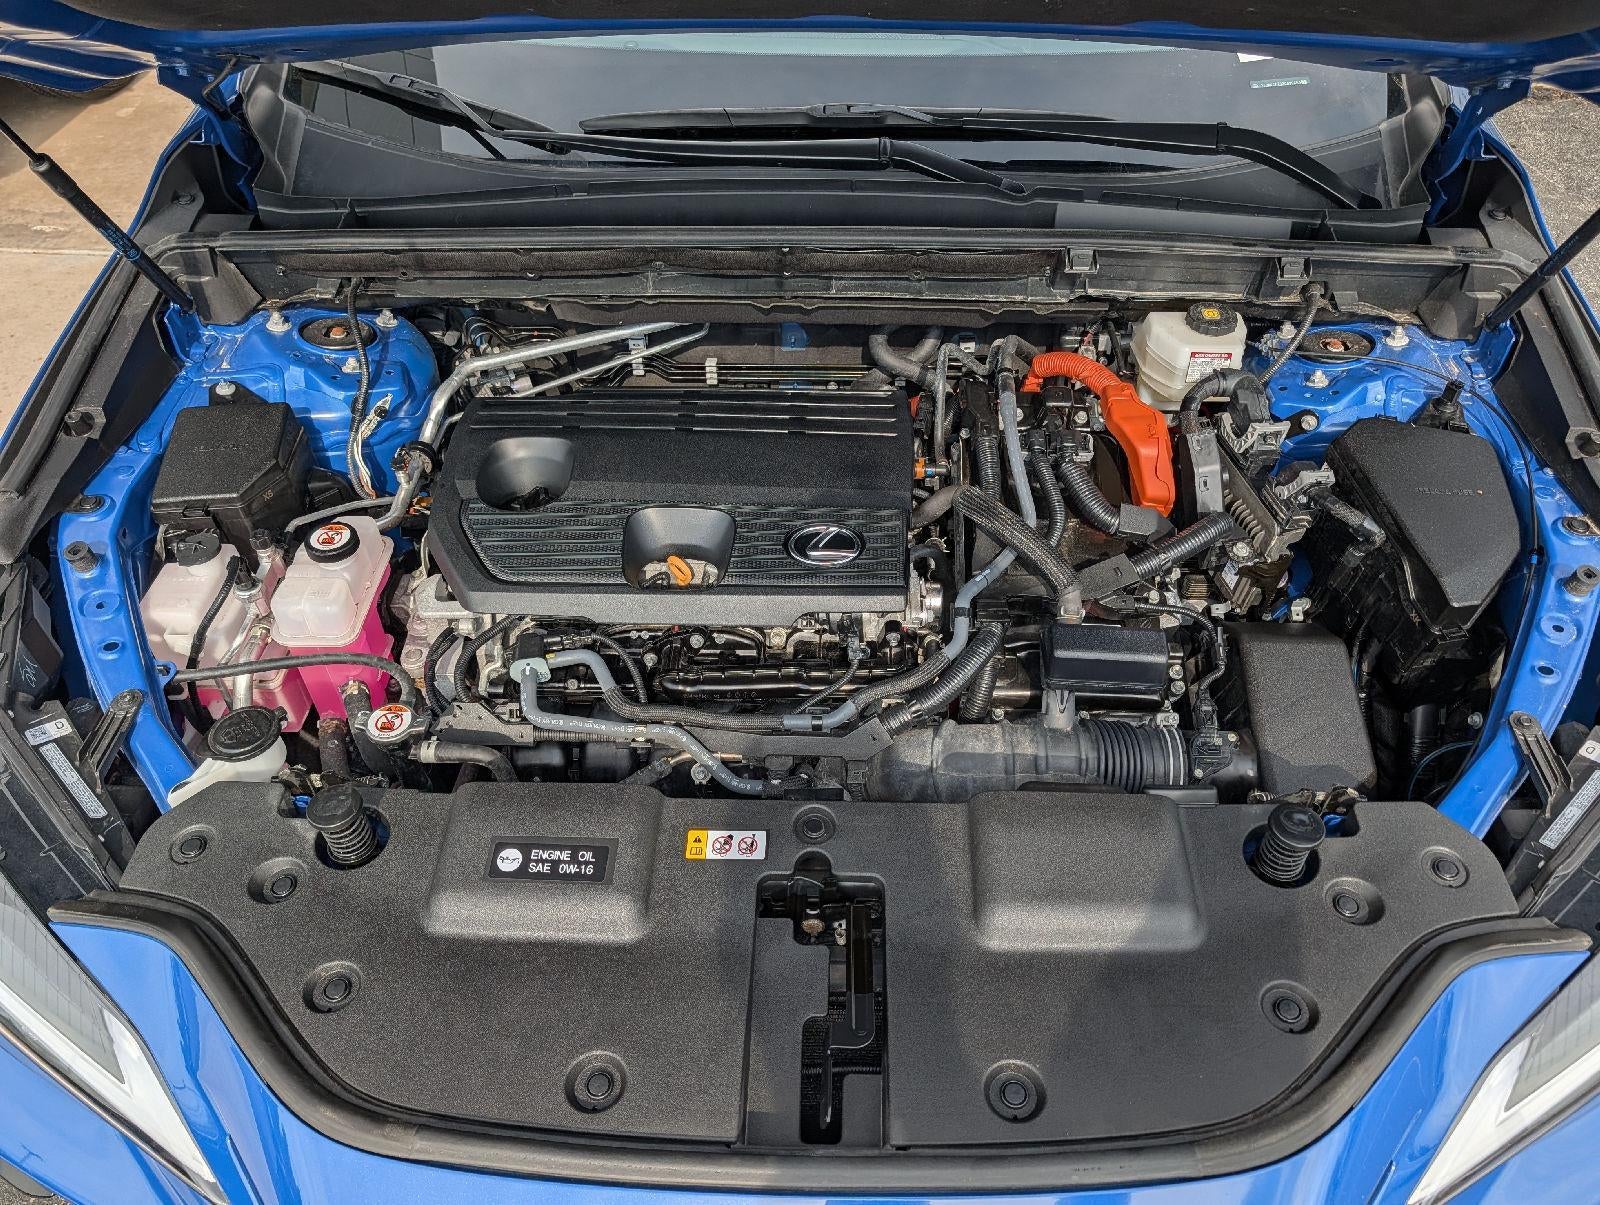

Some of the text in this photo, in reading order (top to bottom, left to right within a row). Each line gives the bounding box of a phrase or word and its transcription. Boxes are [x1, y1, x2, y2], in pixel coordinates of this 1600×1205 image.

[530, 849, 596, 862] ENGINE OIL
[528, 862, 594, 875] SAE 0W-16
